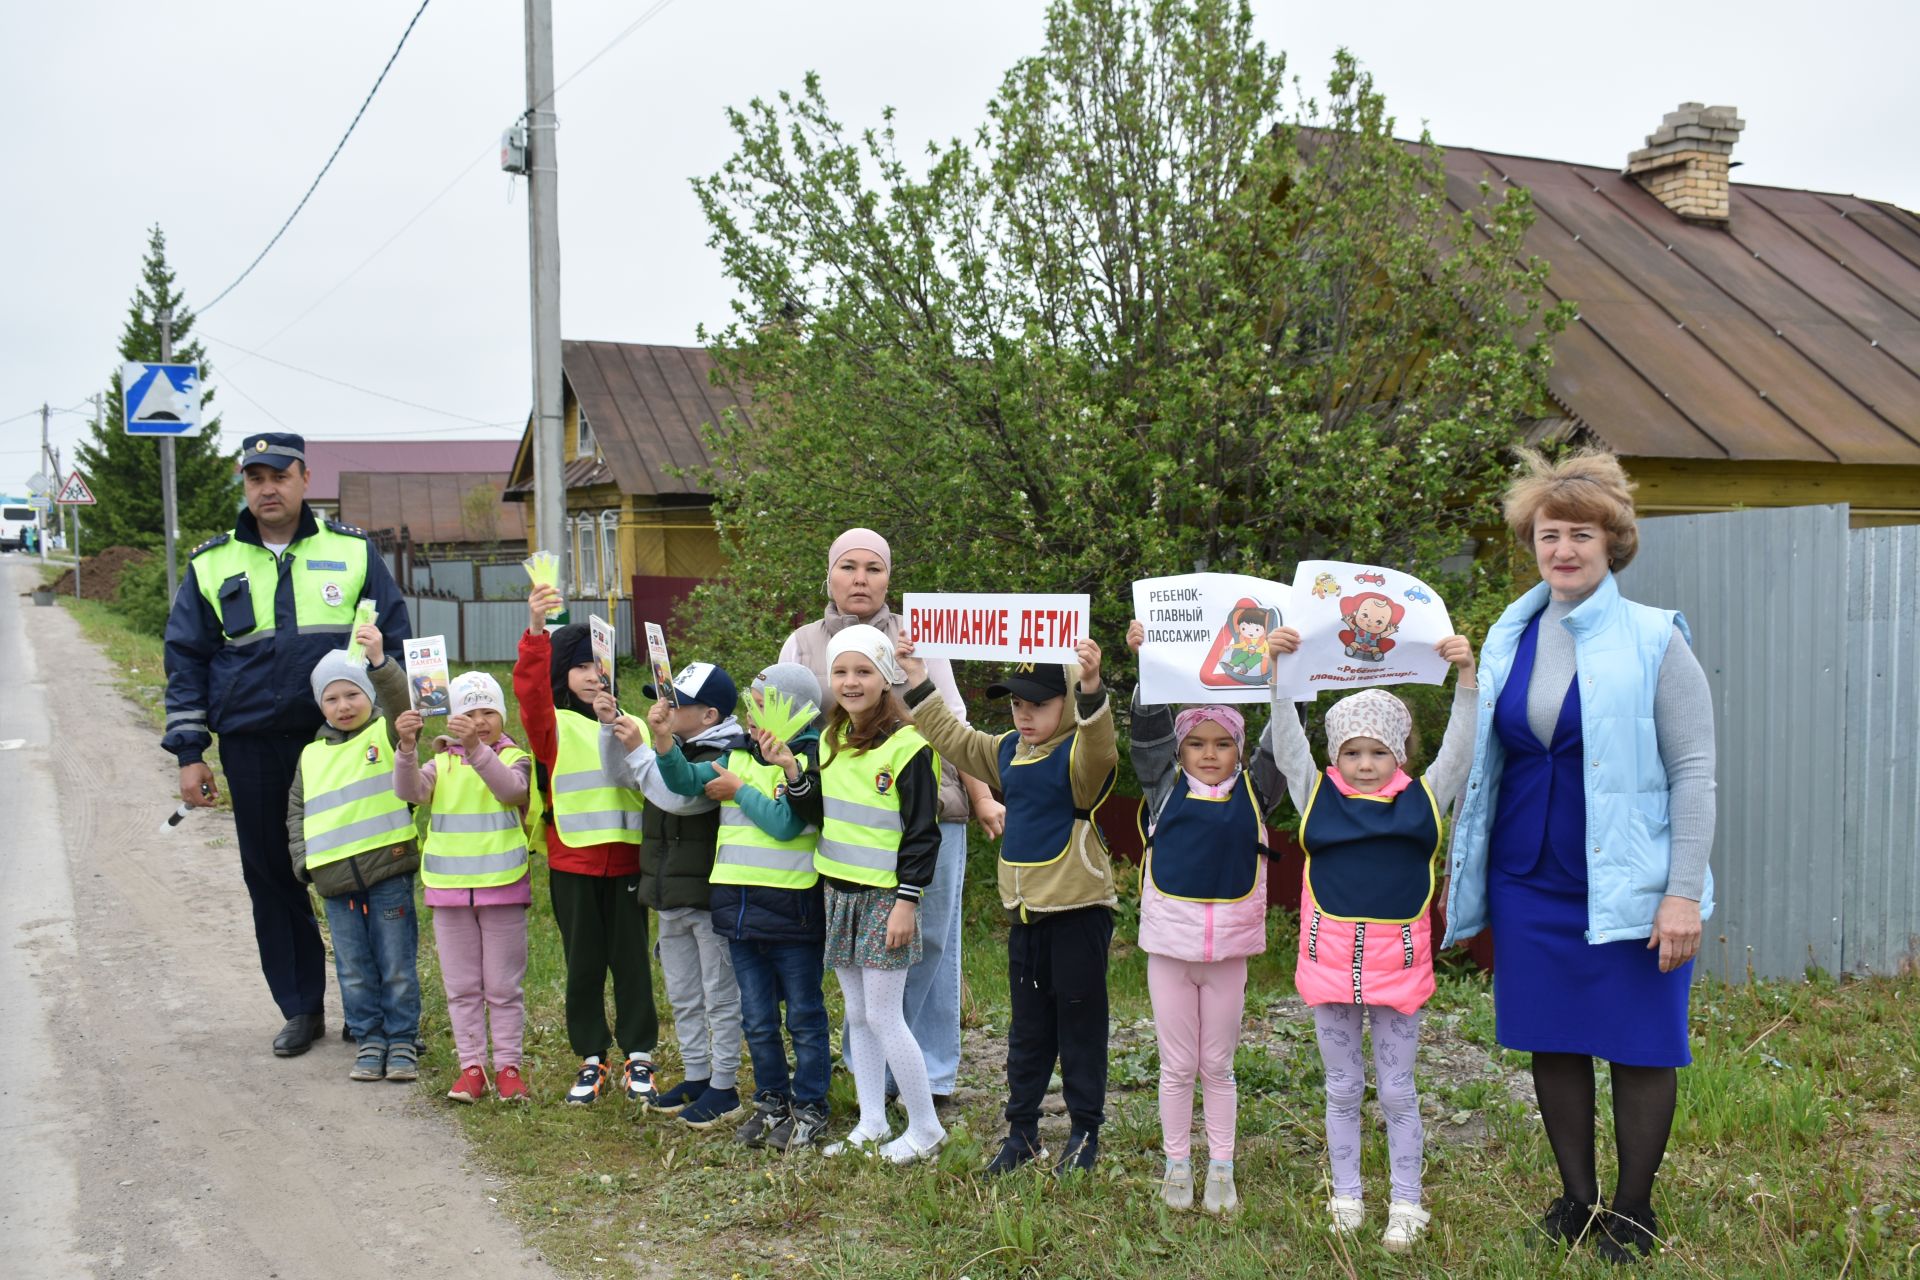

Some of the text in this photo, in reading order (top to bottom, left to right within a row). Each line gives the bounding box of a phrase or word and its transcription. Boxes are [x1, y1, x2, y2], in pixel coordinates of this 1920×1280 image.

[1149, 588, 1203, 602] РЕБЕНОК-
[1149, 606, 1203, 622] ГЛАВНЫЙ
[910, 608, 1079, 655] ВНИМАНИЕ ДЕТИ!
[1147, 629, 1211, 642] ПАССАЖИР!
[1308, 910, 1321, 957] LOVE LOVE
[1355, 924, 1365, 947] LOVE
[1401, 926, 1413, 949] LOVE
[1353, 947, 1362, 968] LOVE
[1352, 968, 1361, 991] LOVE
